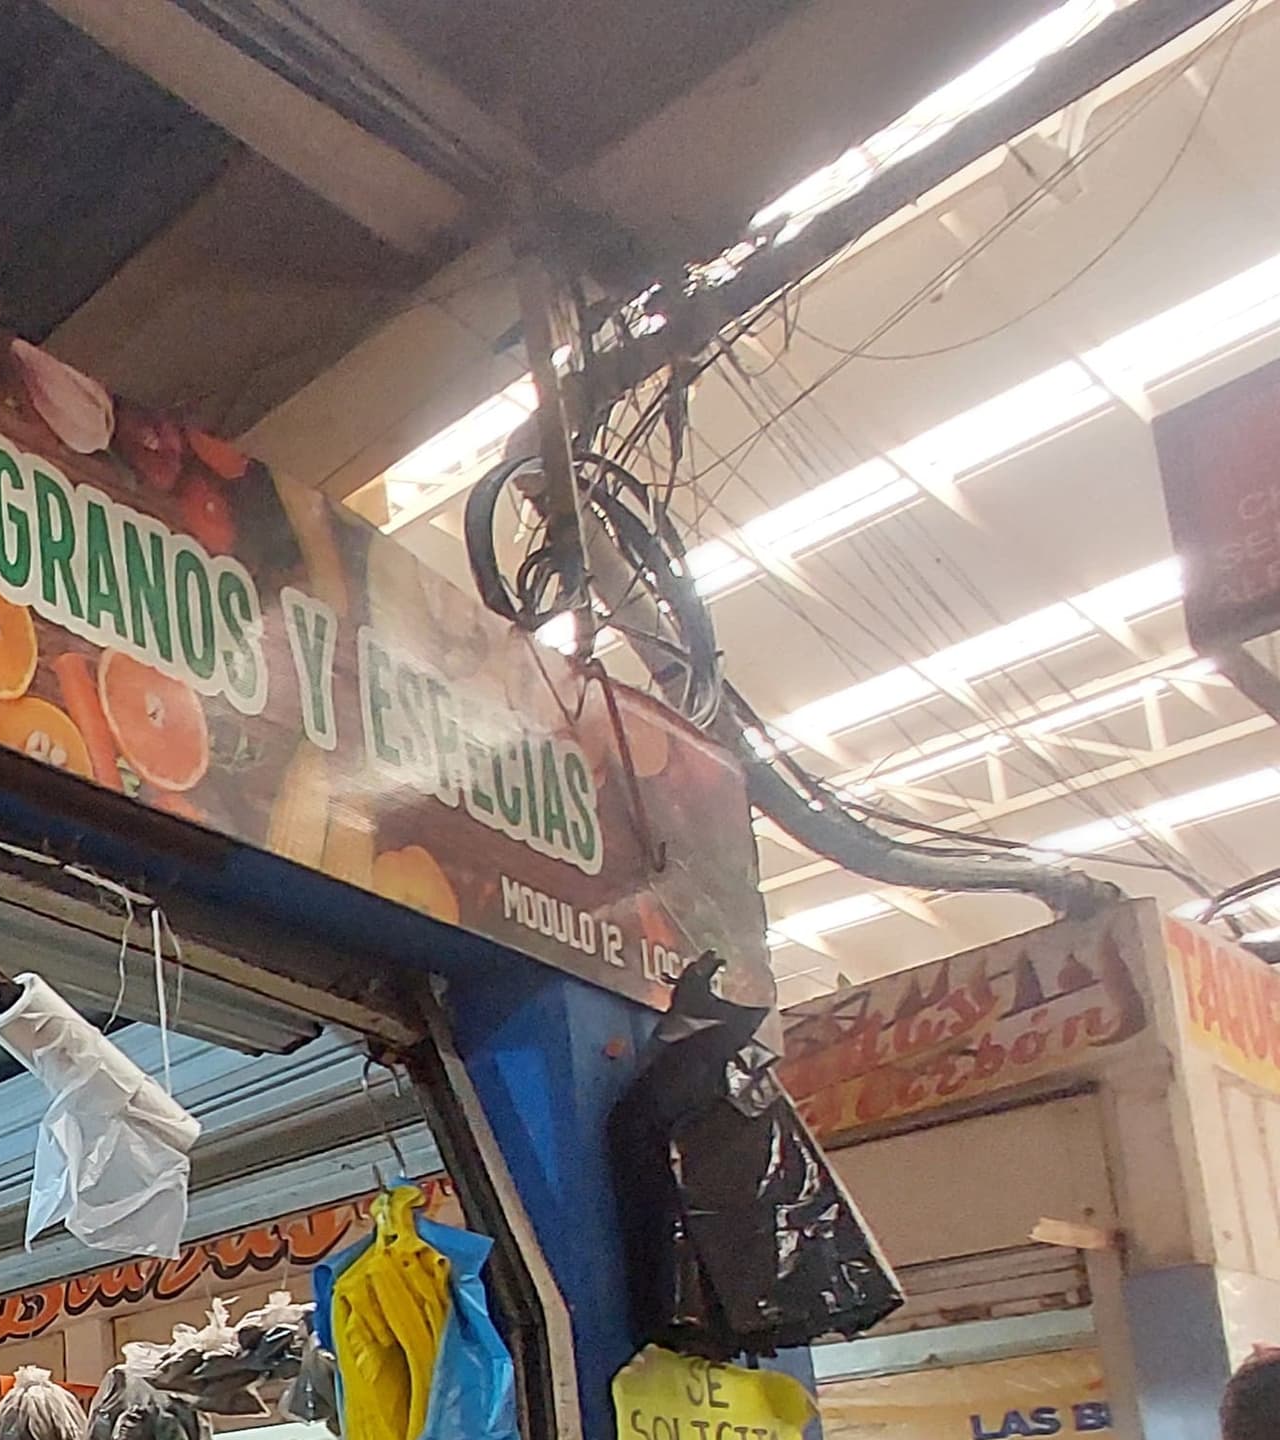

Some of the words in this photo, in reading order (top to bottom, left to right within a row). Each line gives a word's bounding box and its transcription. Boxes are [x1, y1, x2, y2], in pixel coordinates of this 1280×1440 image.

[288, 594, 333, 743] Y
[363, 640, 599, 866] ESPECIAS
[500, 874, 597, 955] MODULO
[600, 920, 626, 969] 12
[686, 1360, 730, 1409] SE
[970, 1406, 1062, 1440] LAS
